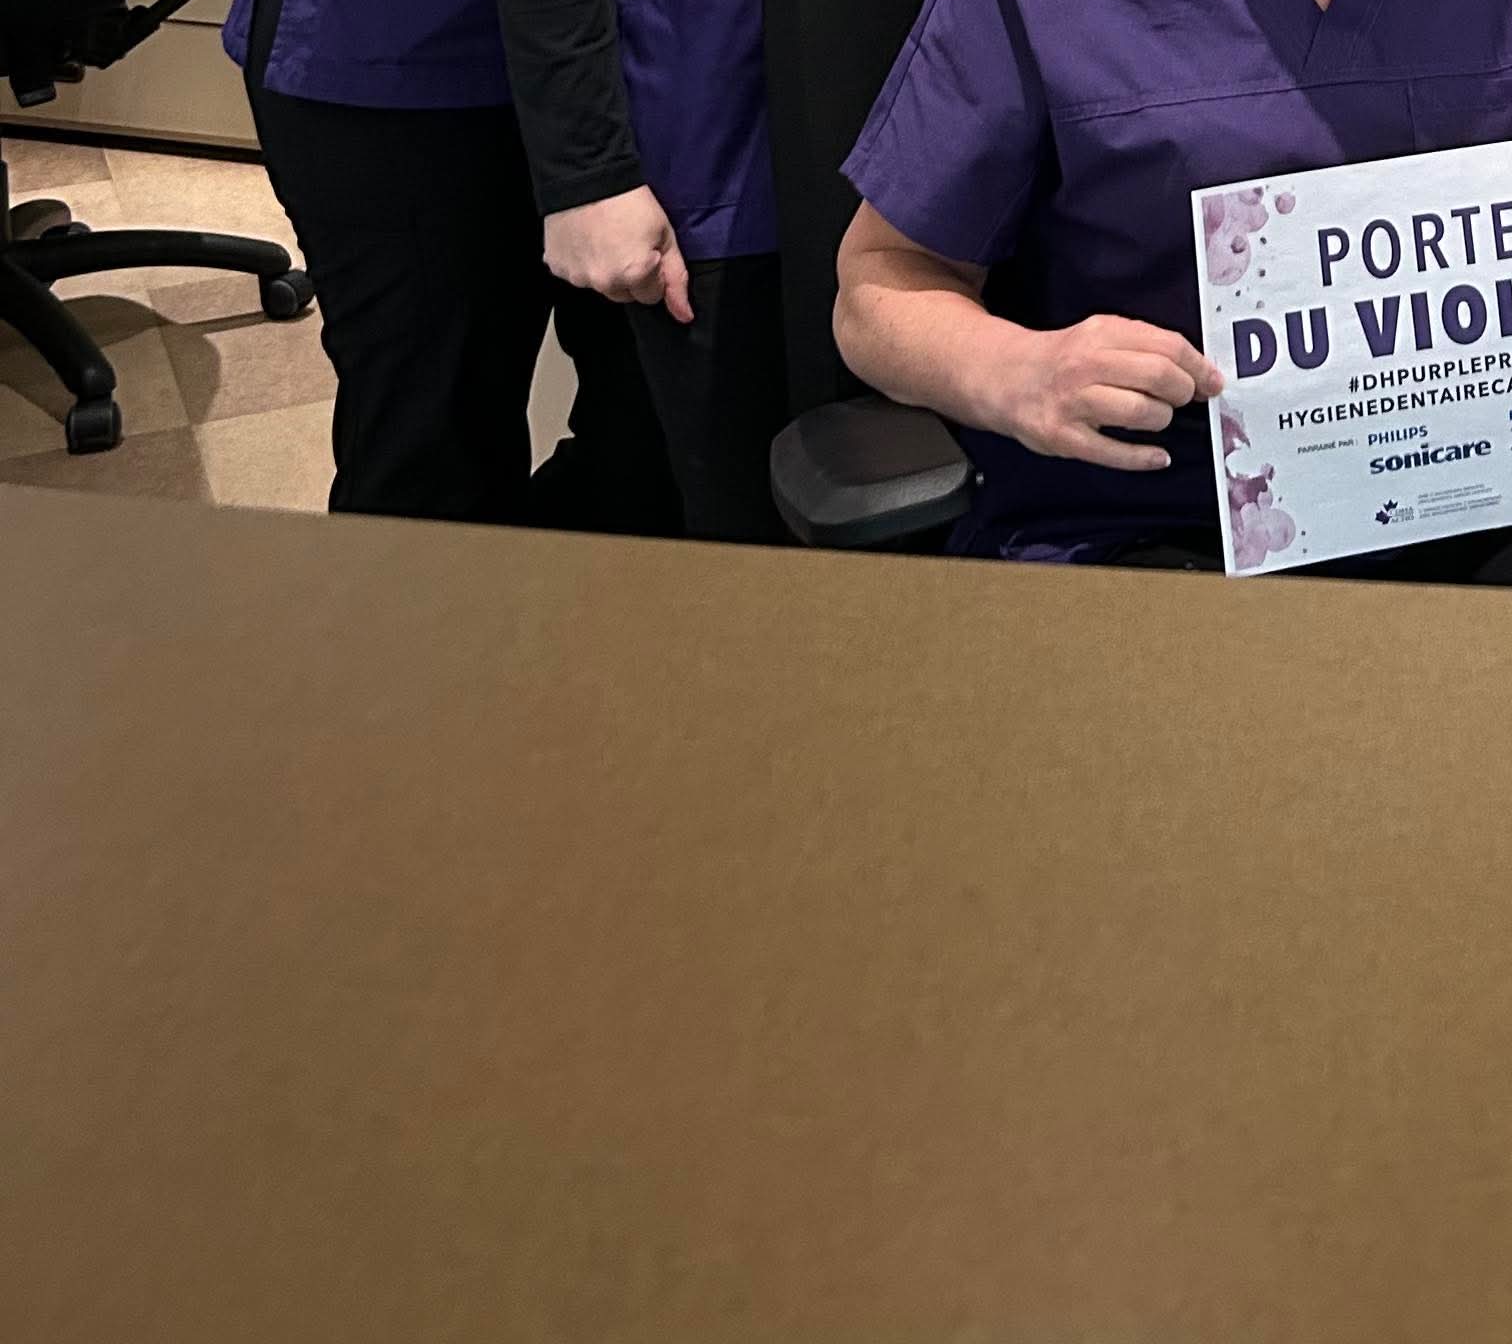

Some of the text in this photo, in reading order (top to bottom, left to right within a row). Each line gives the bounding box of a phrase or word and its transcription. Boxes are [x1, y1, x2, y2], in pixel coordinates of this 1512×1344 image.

[1232, 307, 1331, 380] DU
[1368, 426, 1428, 446] PHILIPS
[1369, 439, 1492, 475] sonicare
